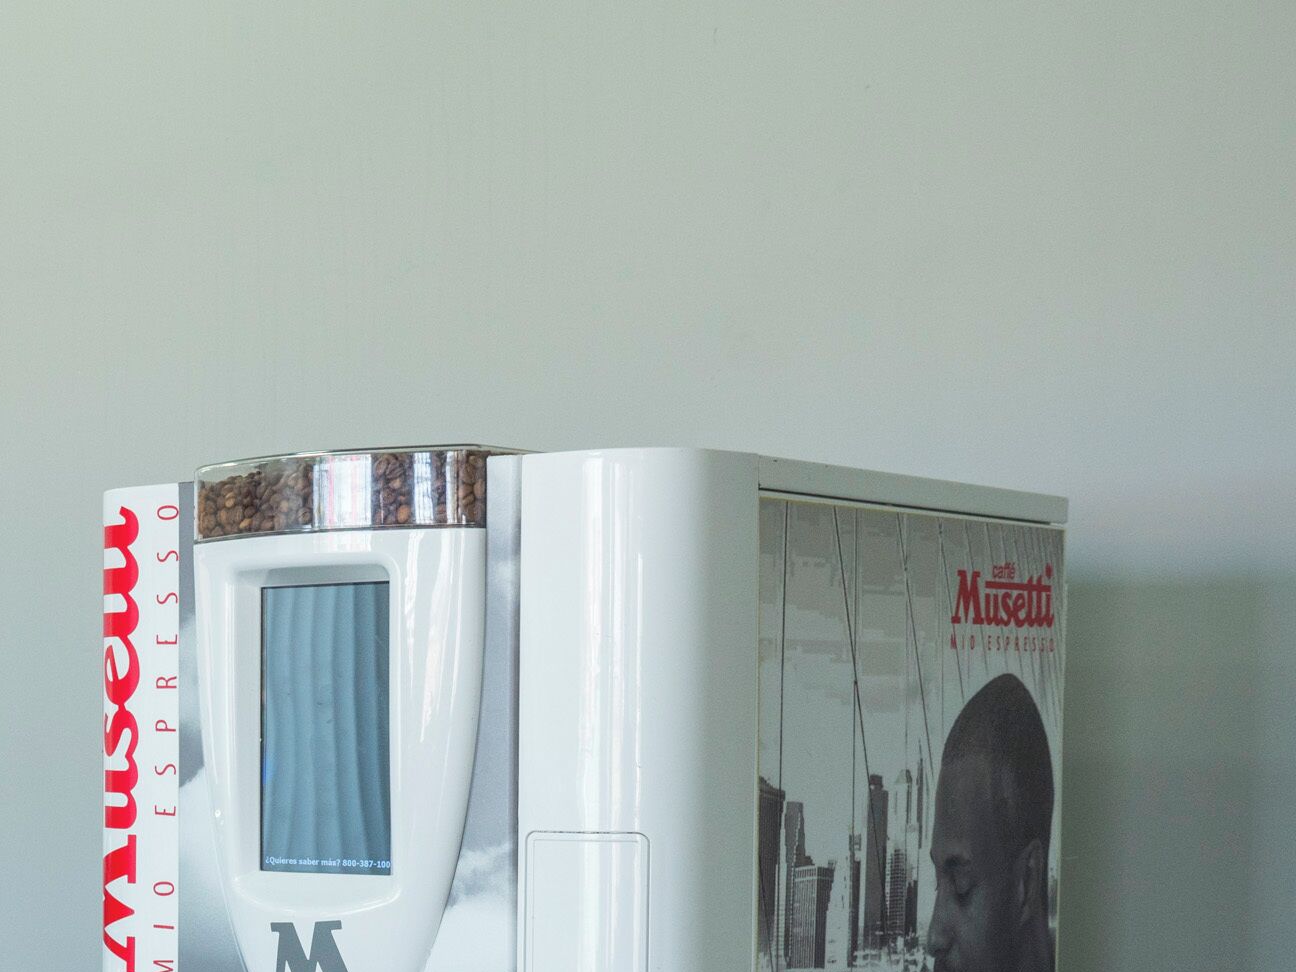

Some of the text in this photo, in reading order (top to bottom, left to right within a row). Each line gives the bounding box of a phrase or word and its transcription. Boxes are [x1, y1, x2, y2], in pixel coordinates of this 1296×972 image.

[951, 563, 1054, 628] Musetti
[154, 505, 180, 817] ESPRESSO
[950, 634, 1055, 652] MIO ESPRESSO
[265, 856, 391, 869] ¿Quieres saber más? 800-387-100
